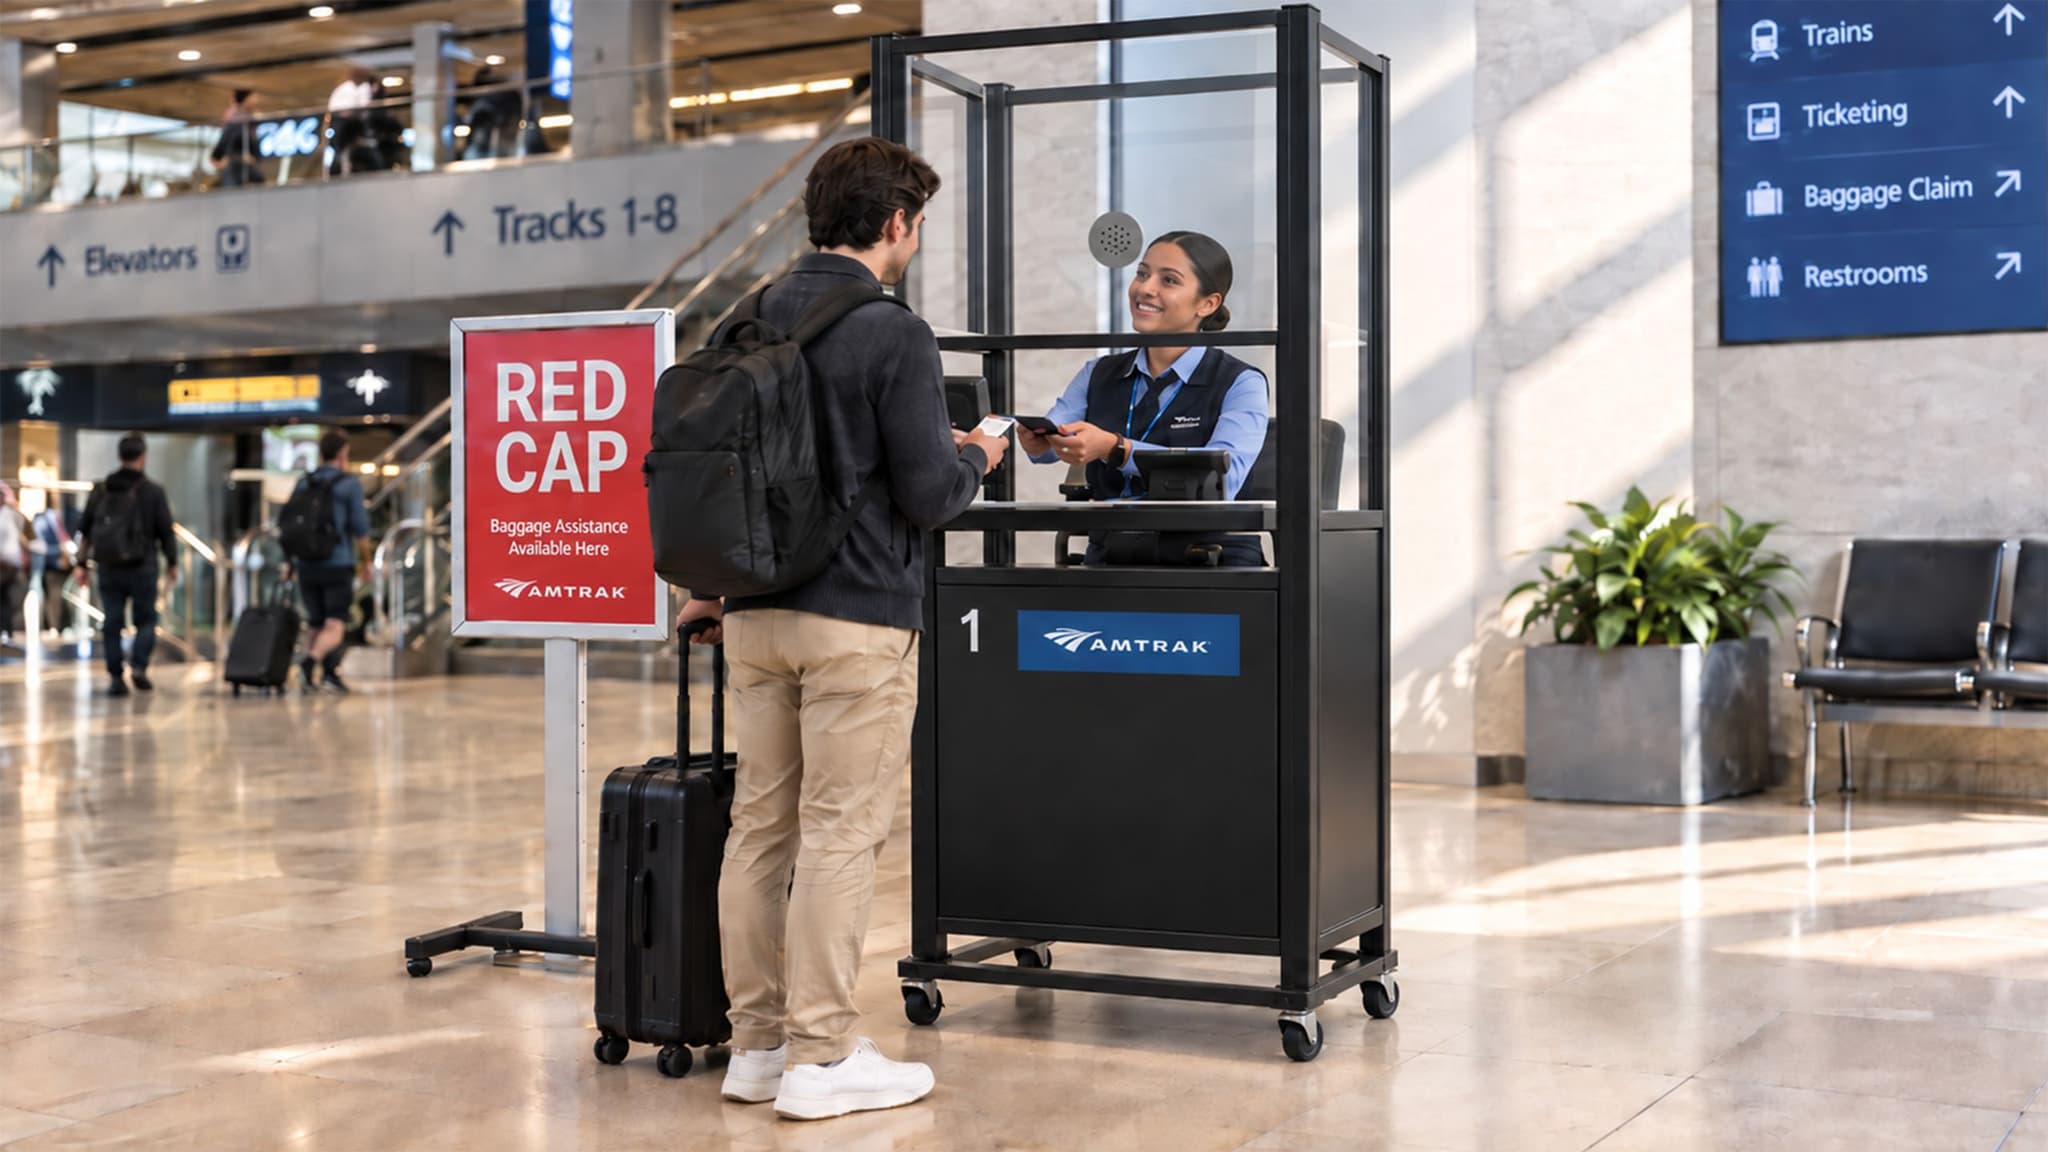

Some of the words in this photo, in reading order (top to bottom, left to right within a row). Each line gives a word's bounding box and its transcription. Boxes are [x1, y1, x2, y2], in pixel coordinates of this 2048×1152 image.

[1802, 20, 1873, 46] Trains
[1802, 99, 1908, 128] Ticketing
[1805, 183, 1902, 211] Baggage
[1909, 175, 1973, 201] Claim
[494, 199, 606, 246] Tracks
[624, 193, 678, 234] 1-8
[85, 245, 197, 276] Elevators
[1805, 264, 1928, 288] Restrooms
[496, 360, 627, 422] RED
[495, 430, 628, 493] CAP
[490, 518, 551, 537] Baggage
[555, 518, 628, 534] Assistance
[508, 540, 571, 556] Available
[576, 541, 609, 556] Here
[528, 585, 624, 599] AMTRAK
[961, 608, 979, 652] 1
[1089, 638, 1210, 653] AMTRAK
